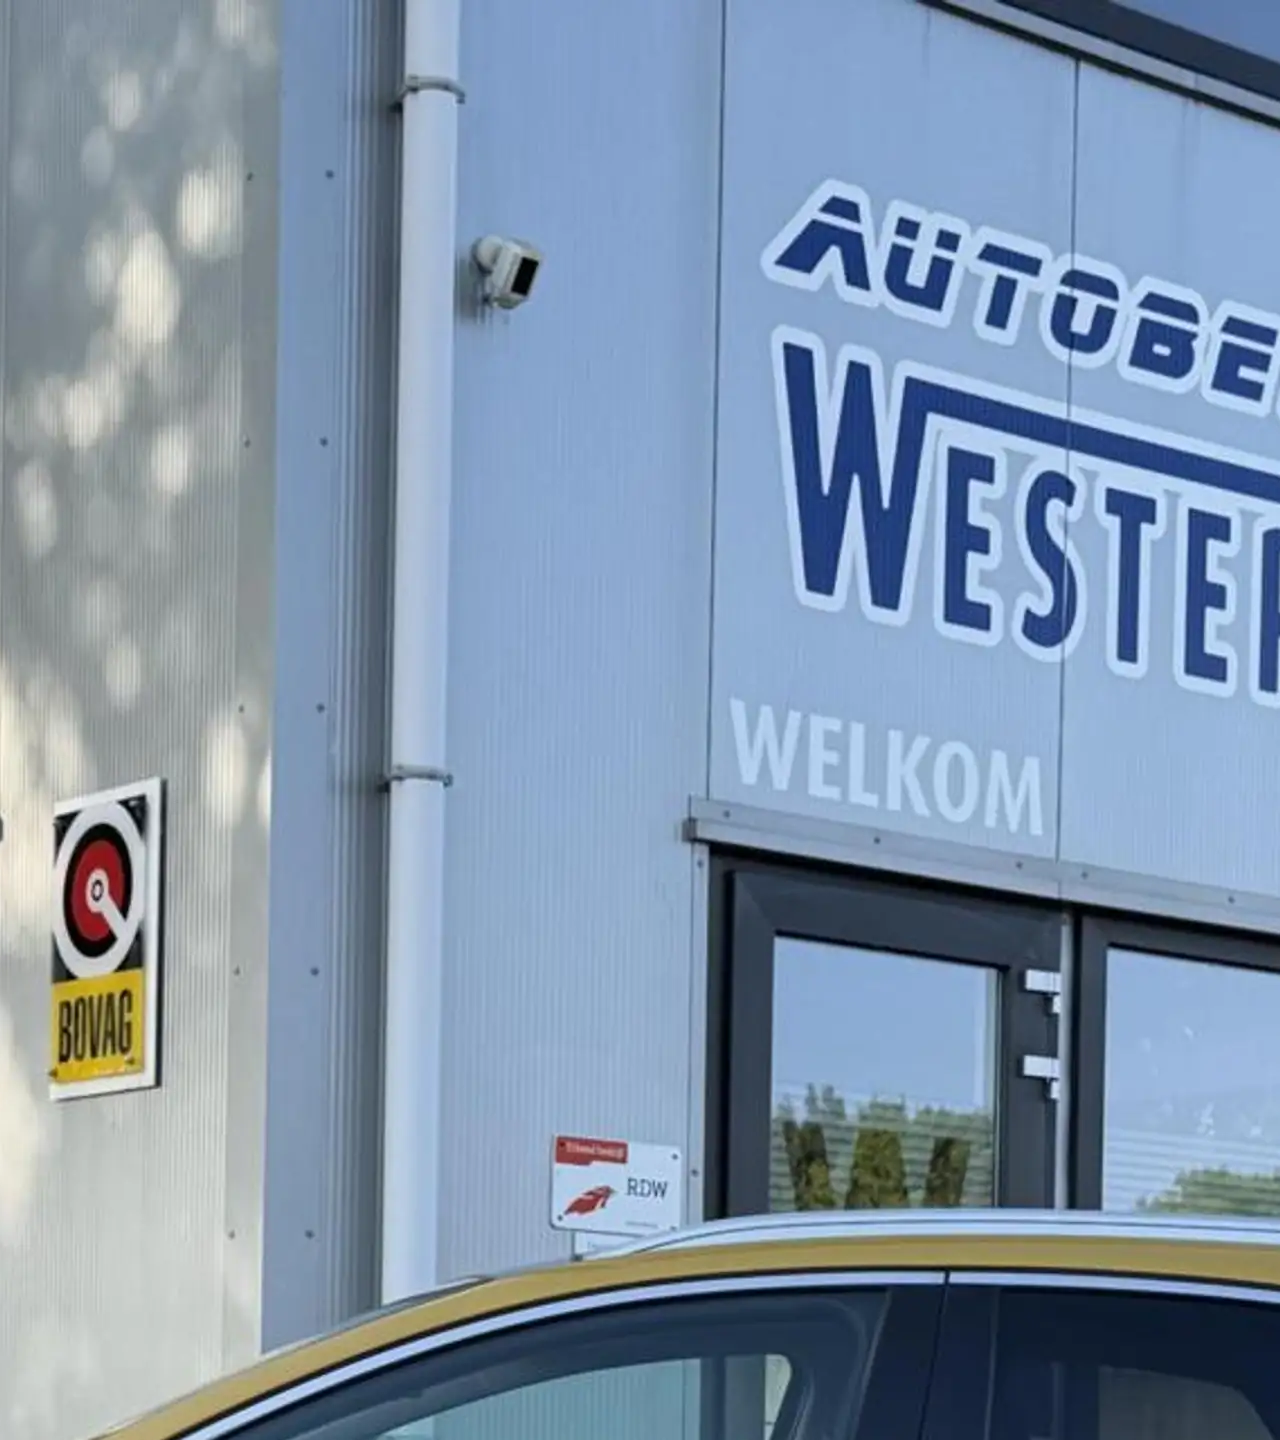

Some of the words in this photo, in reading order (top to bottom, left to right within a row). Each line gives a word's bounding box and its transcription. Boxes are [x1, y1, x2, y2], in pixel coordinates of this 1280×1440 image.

[729, 699, 1045, 837] WELKOM
[58, 988, 133, 1064] BOVAG
[625, 1177, 669, 1200] RDW
